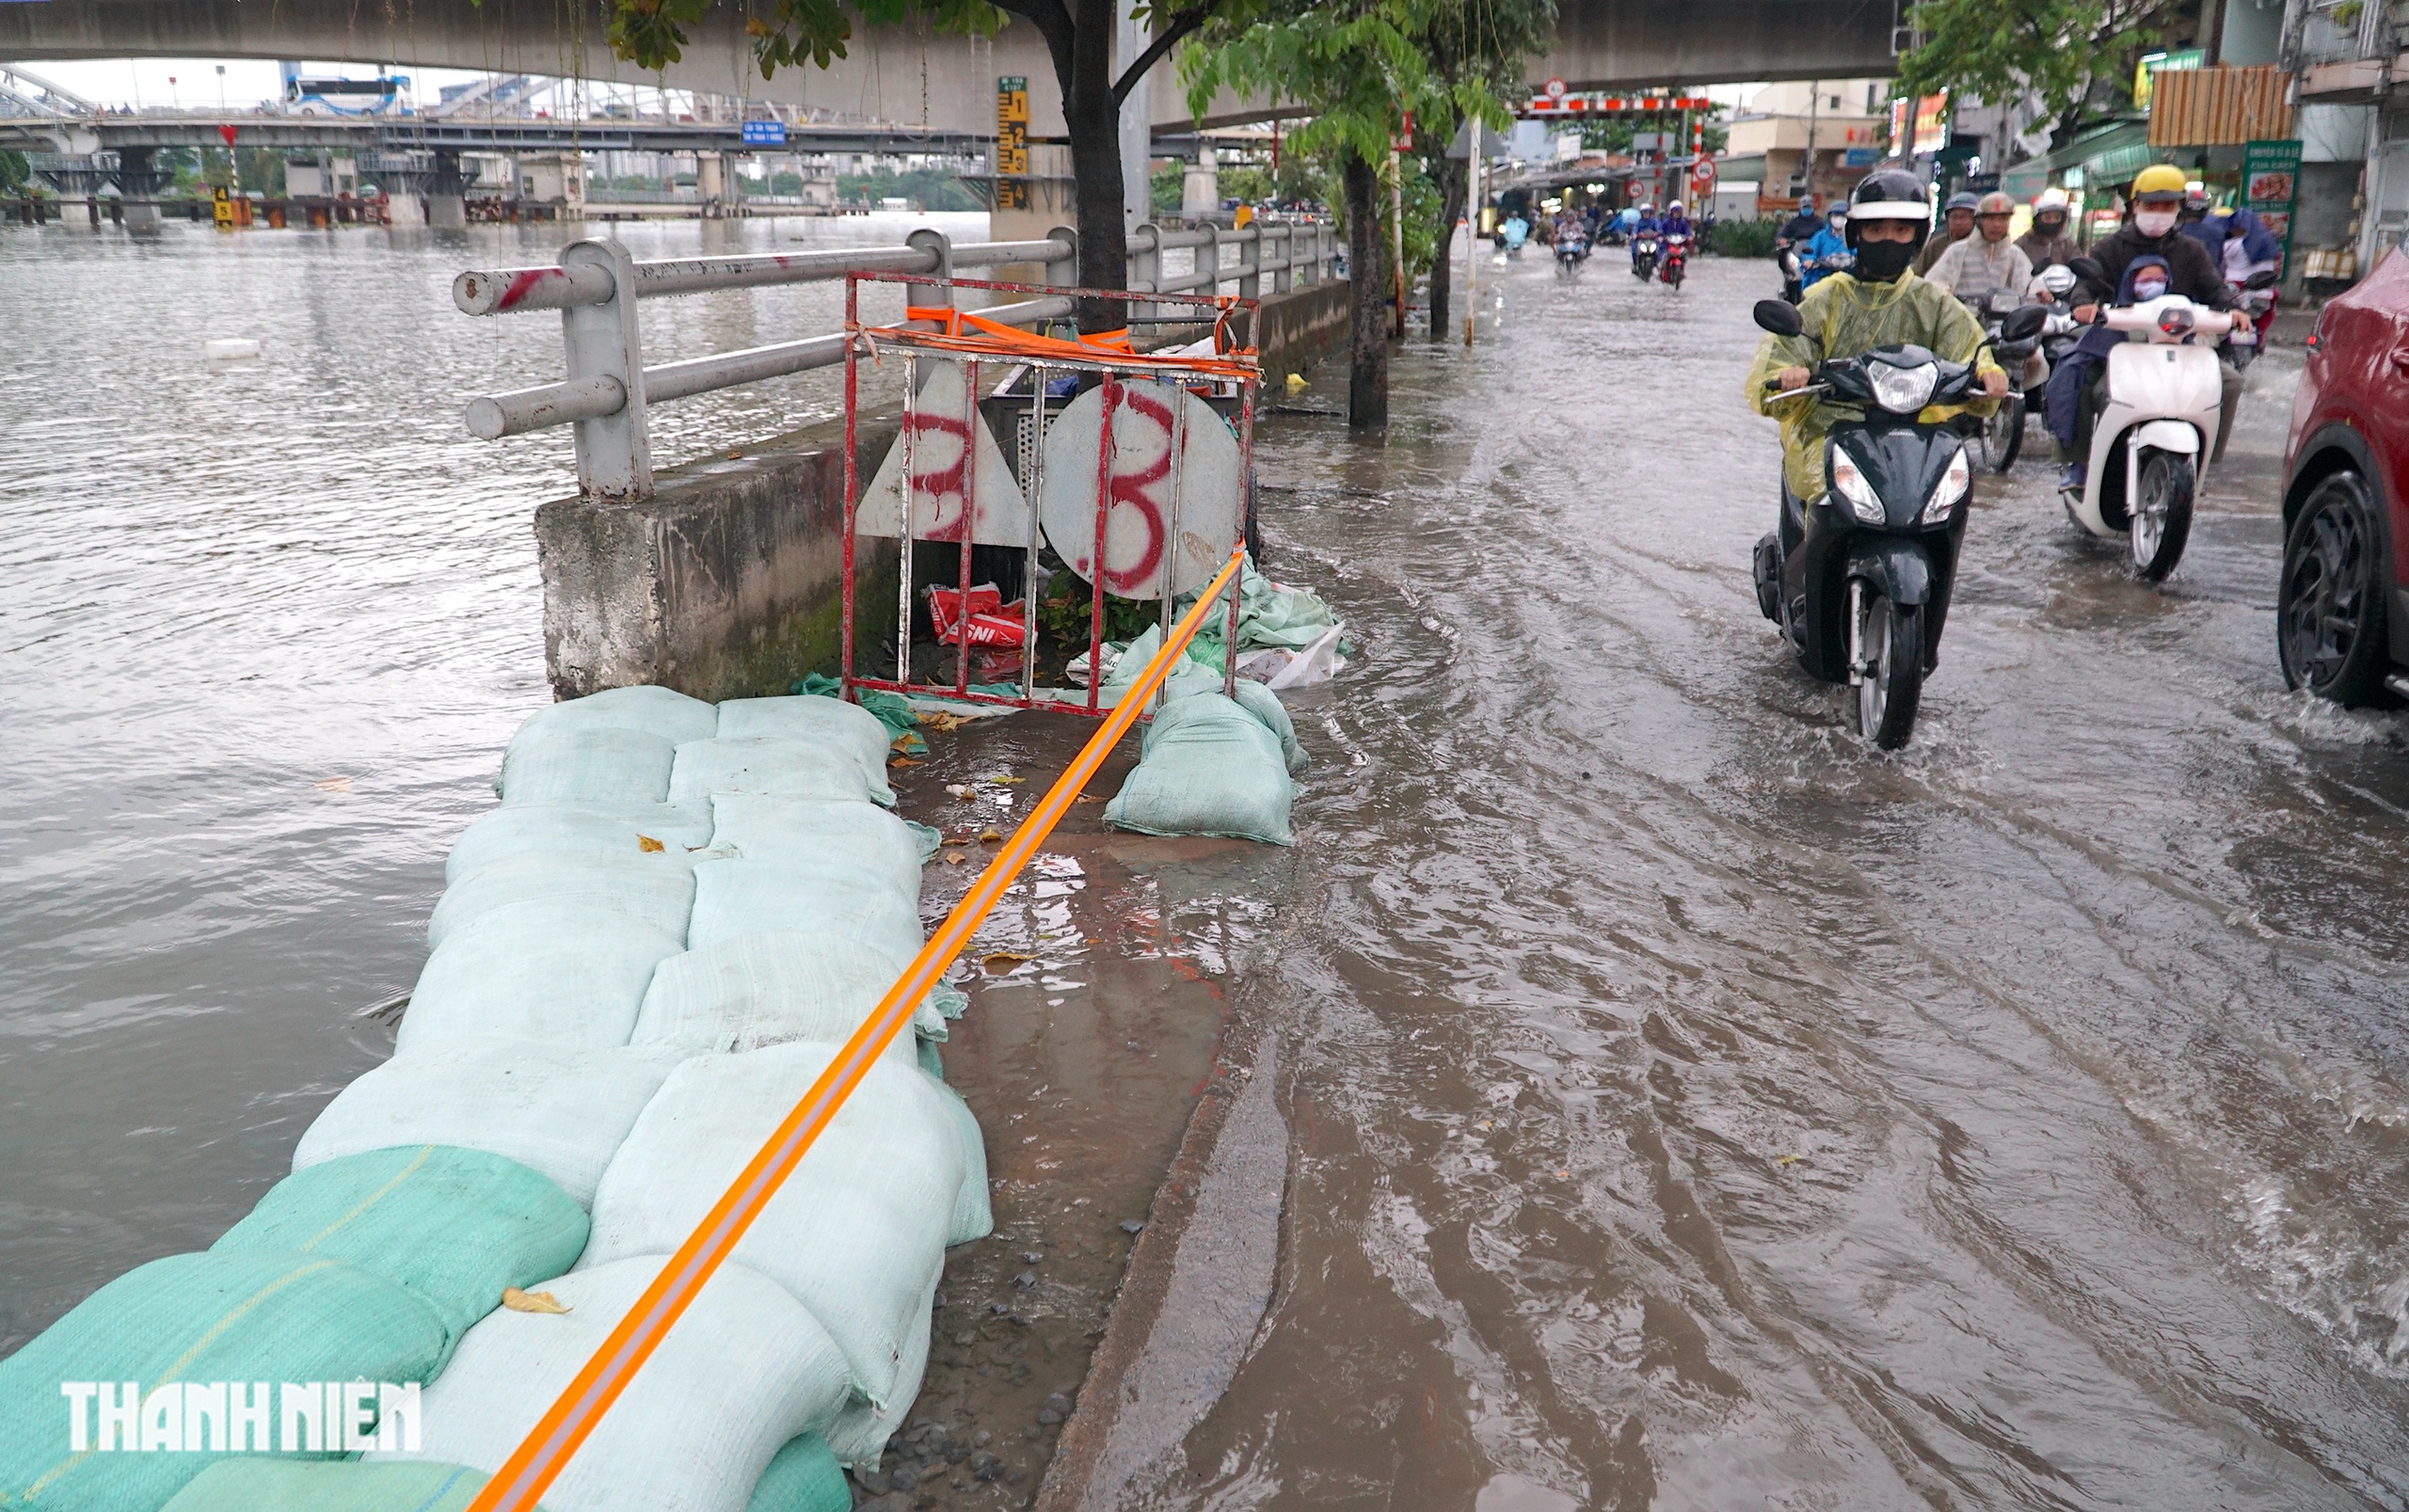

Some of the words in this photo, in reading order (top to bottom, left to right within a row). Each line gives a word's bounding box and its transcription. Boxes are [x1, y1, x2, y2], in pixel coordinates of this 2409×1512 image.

[1015, 98, 1022, 113] 1
[1014, 127, 1024, 143] 2
[1015, 184, 1024, 200] 4
